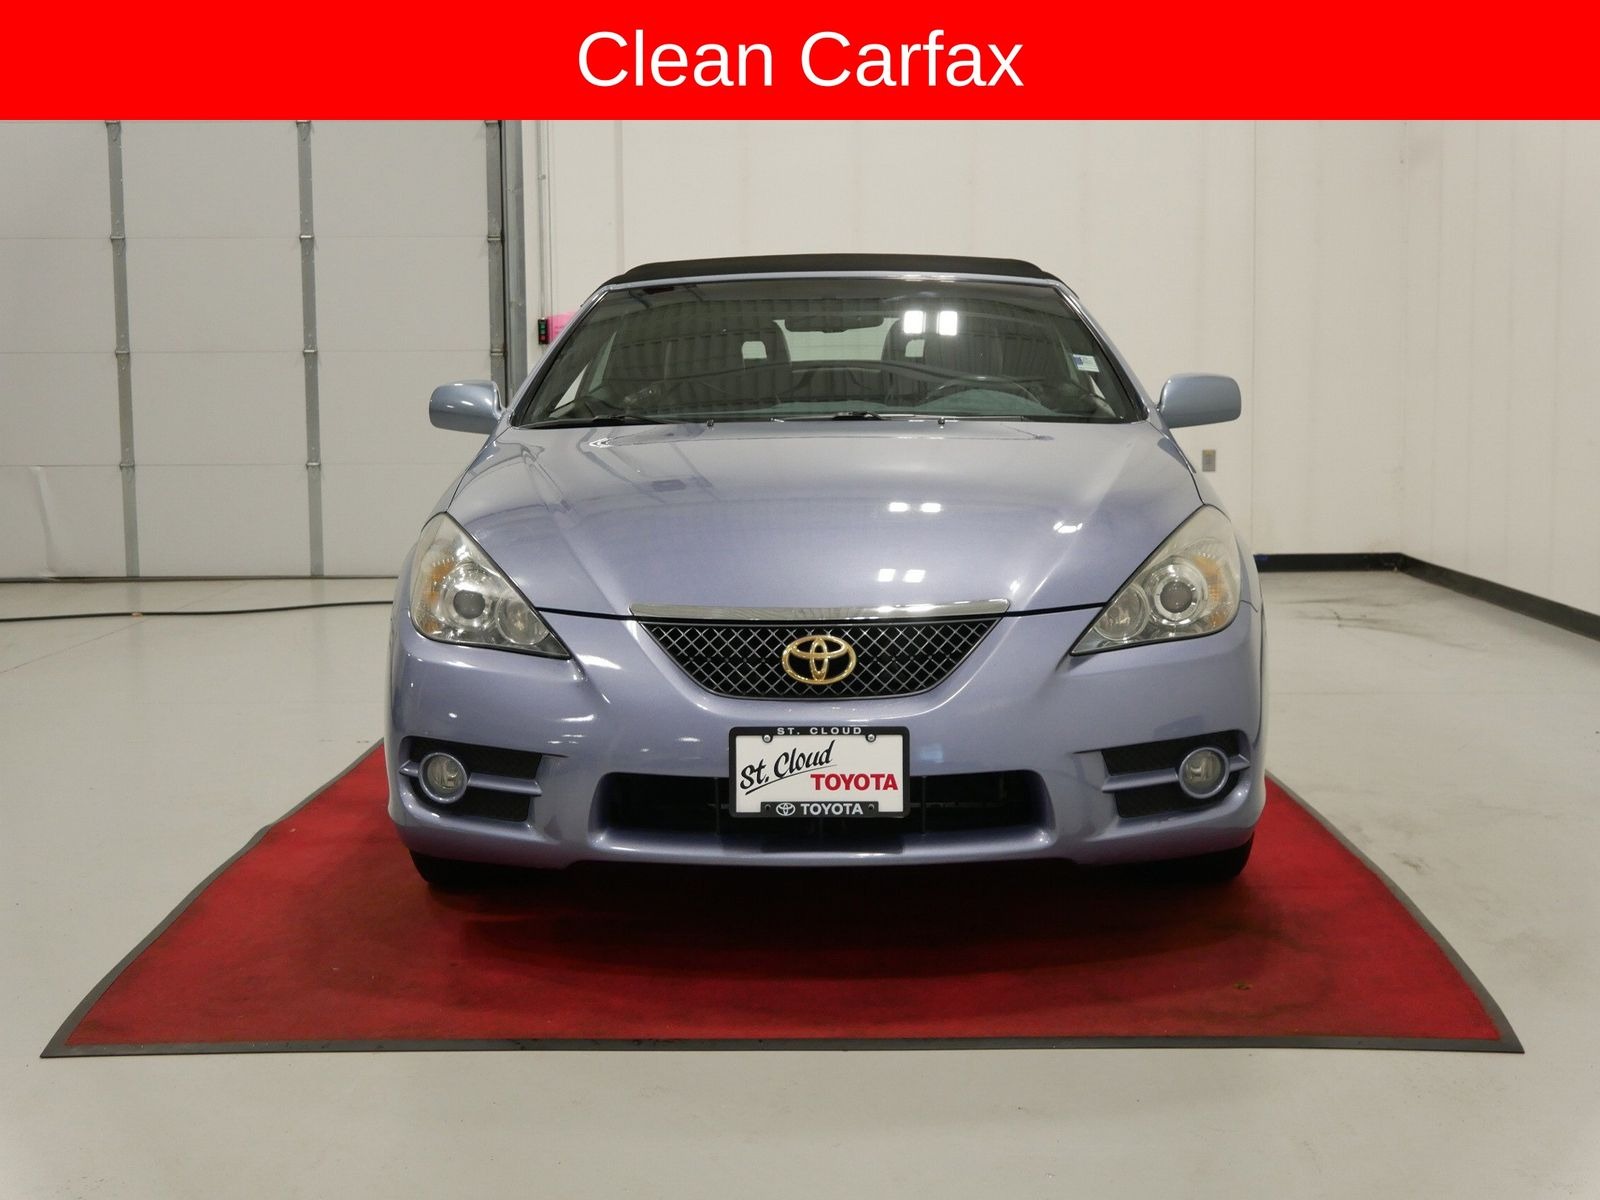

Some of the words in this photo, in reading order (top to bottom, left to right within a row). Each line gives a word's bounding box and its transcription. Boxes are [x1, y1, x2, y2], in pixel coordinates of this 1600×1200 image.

[776, 727, 800, 735] ST.
[809, 727, 862, 735] CLOUD
[740, 759, 770, 790] St.
[773, 739, 836, 778] Cloud
[810, 773, 899, 791] TOYOTA
[800, 803, 864, 815] TOYOTA
